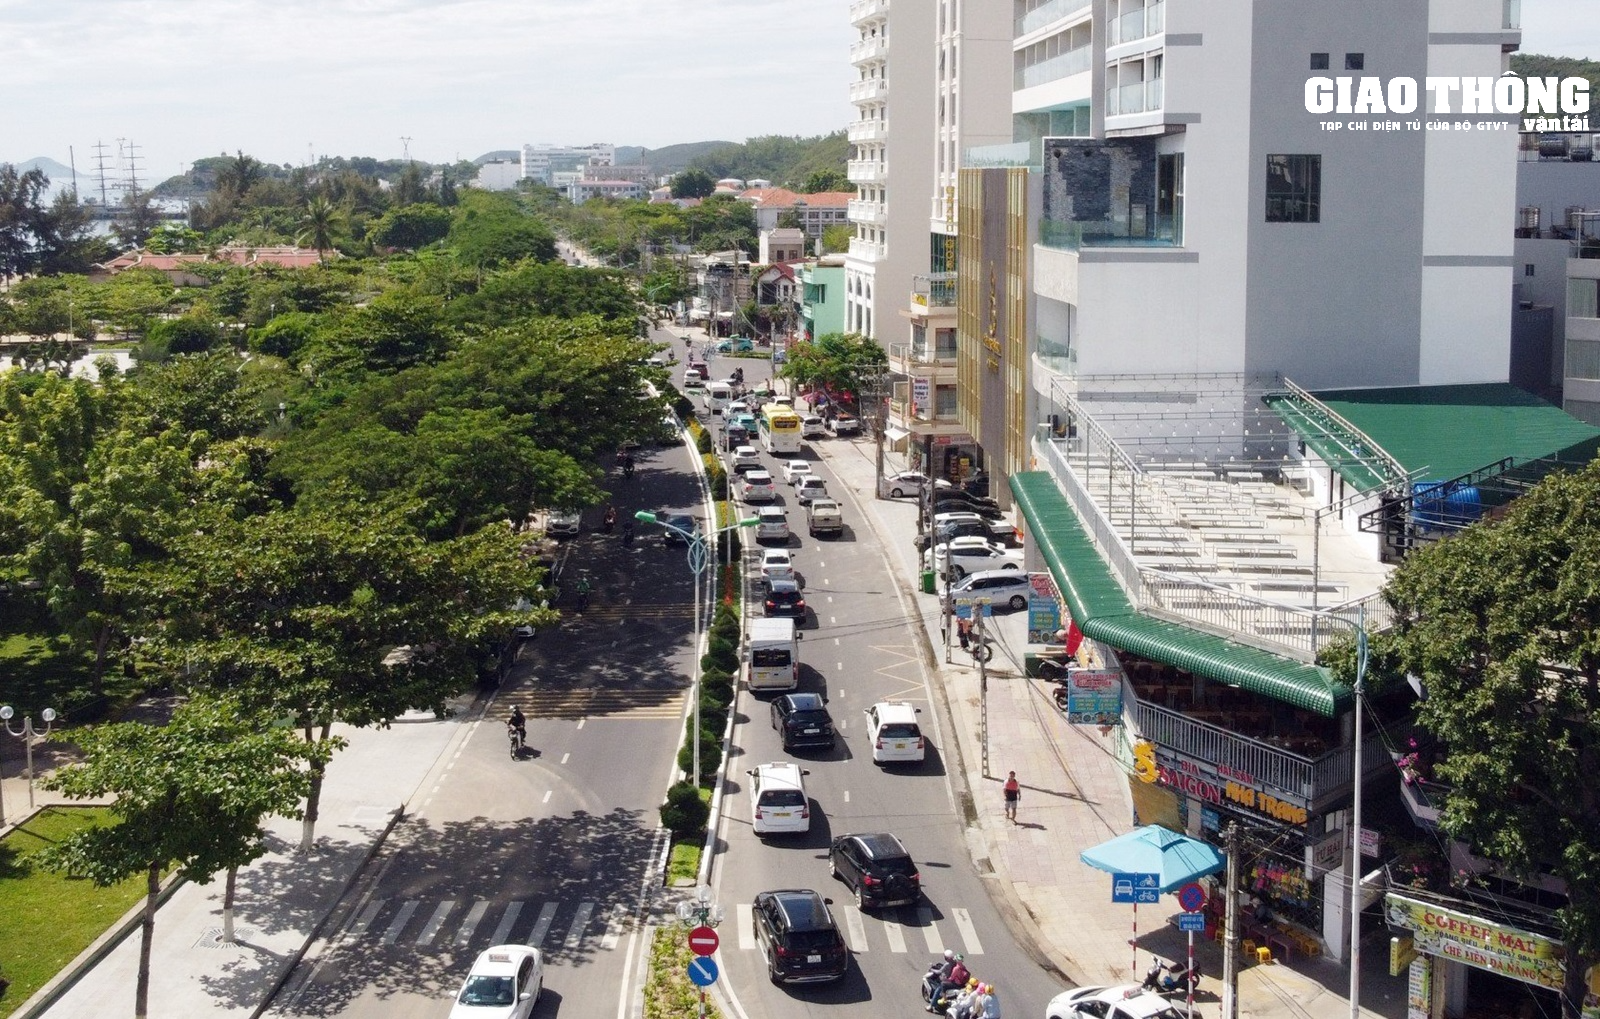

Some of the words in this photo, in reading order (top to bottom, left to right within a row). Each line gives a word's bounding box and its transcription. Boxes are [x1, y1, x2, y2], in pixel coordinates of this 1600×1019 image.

[1159, 764, 1221, 805] SAIGON
[1180, 760, 1201, 777] BIA
[1225, 780, 1255, 808] NHA
[1257, 791, 1308, 825] TRANG
[1424, 912, 1493, 942] COFFEE
